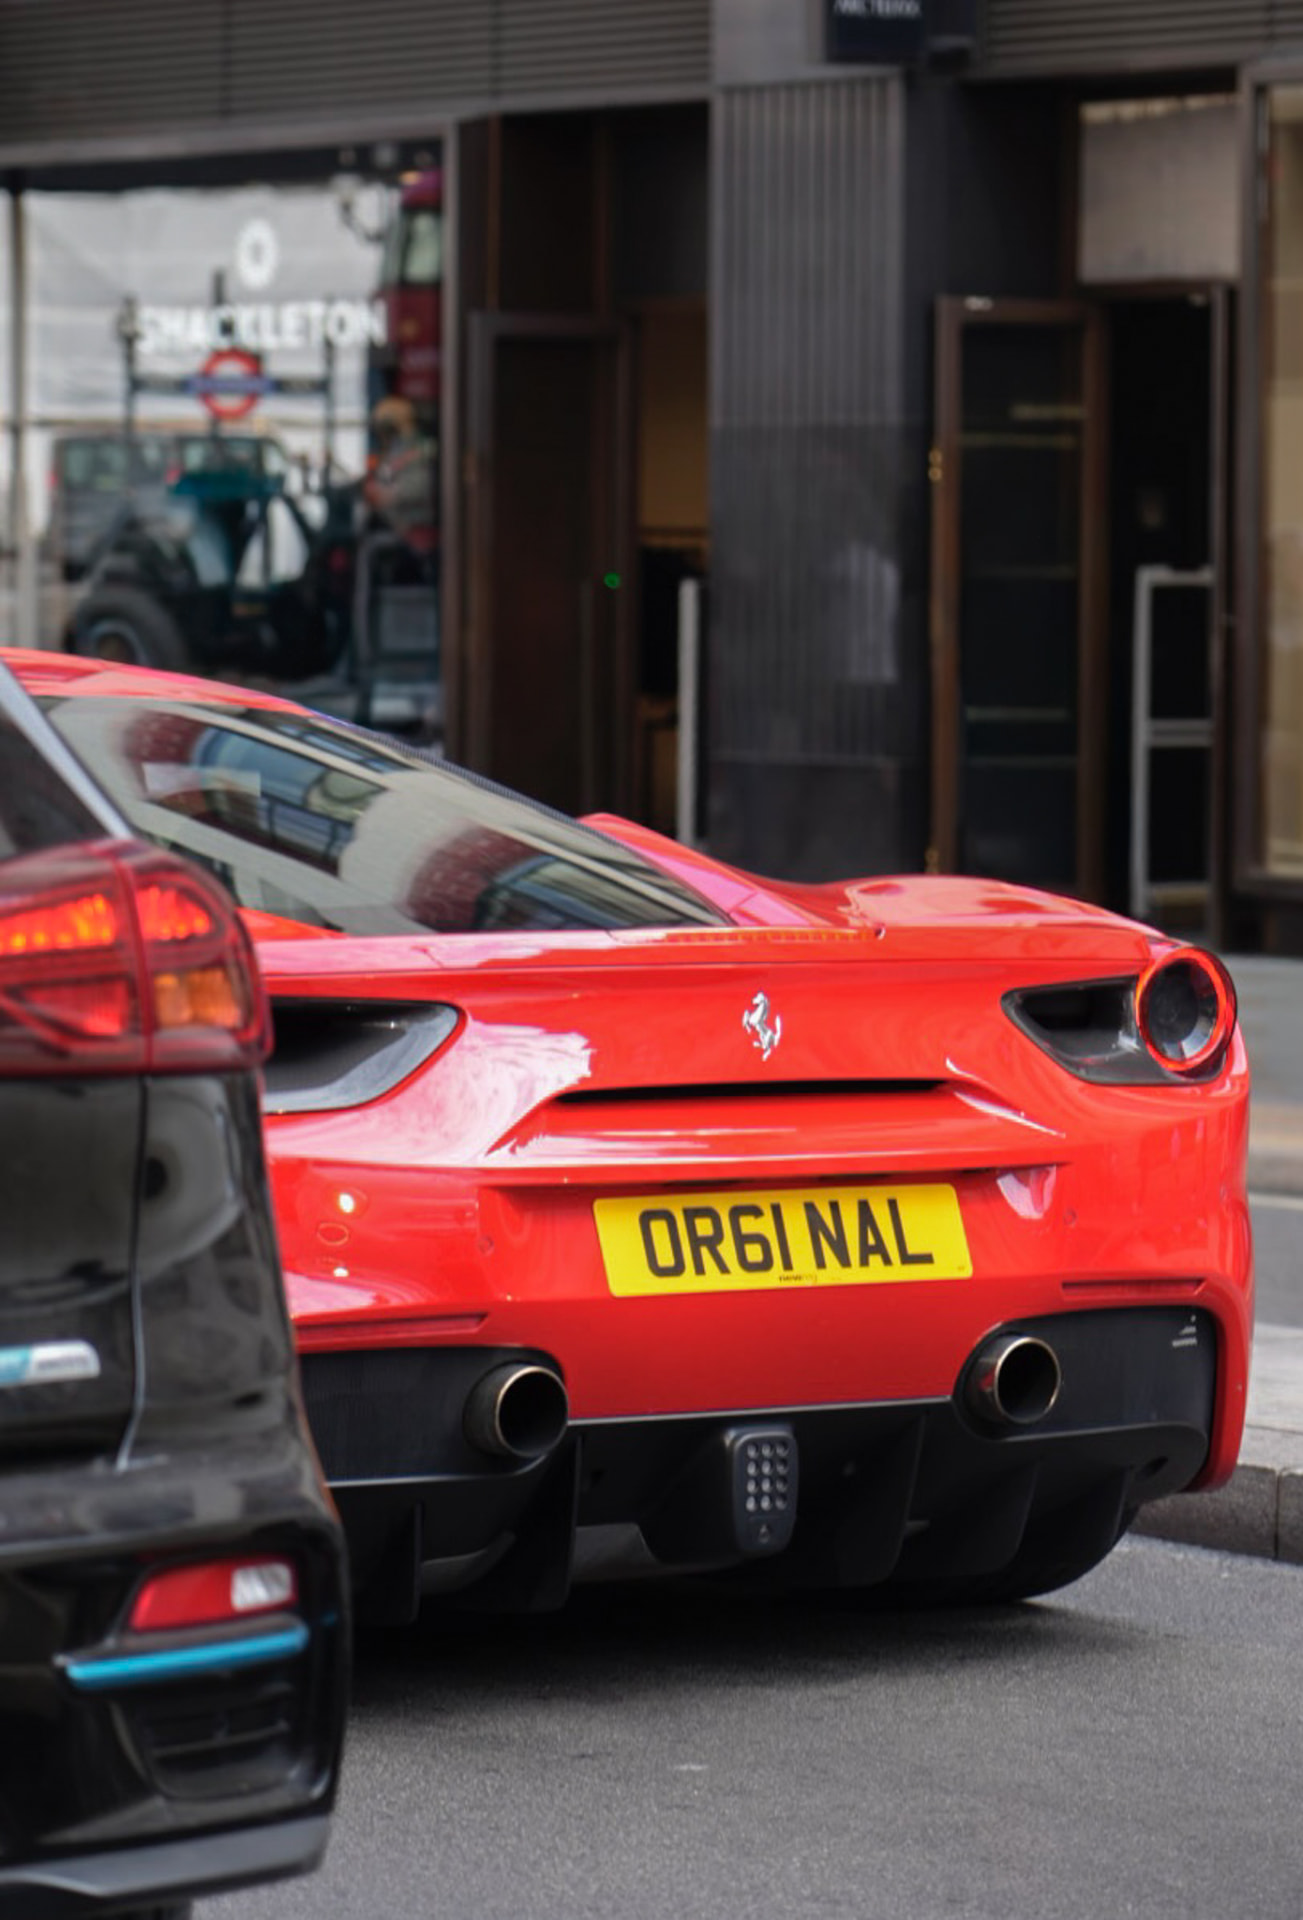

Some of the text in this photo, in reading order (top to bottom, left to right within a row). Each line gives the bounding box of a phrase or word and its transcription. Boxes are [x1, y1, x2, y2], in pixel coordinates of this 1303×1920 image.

[136, 299, 387, 352] SHACKLETON
[639, 1198, 934, 1277] OR61 NAL
